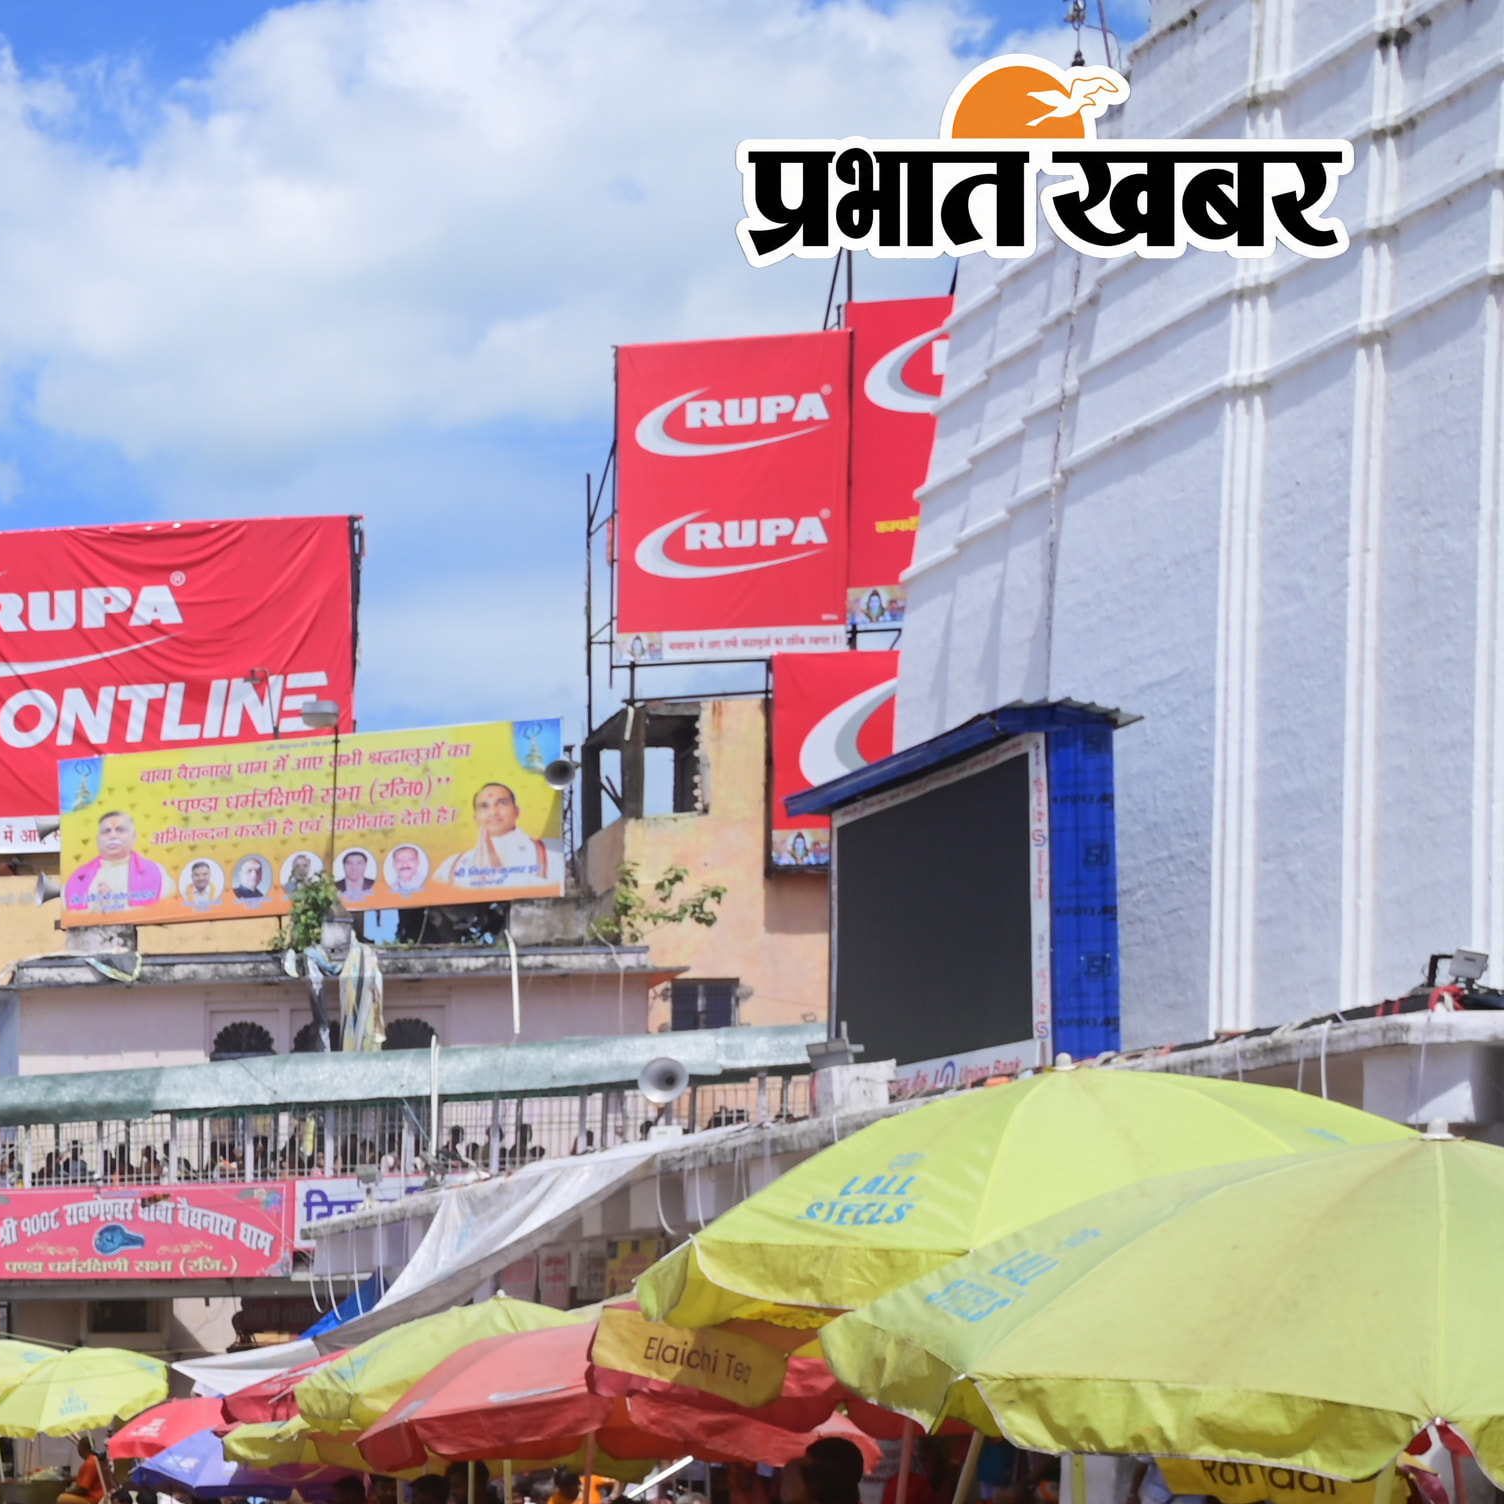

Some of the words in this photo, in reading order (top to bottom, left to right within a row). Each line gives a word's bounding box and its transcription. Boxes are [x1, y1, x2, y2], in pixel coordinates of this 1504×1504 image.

[684, 395, 829, 430] RUPA
[684, 516, 829, 551] RUPA
[293, 755, 323, 770] आए
[448, 744, 473, 759] का
[3, 825, 14, 843] में
[19, 828, 46, 846] आ
[993, 1057, 1021, 1077] Bank
[838, 1174, 919, 1197] LALL
[795, 1201, 916, 1226] STEELS
[20, 1208, 61, 1238] १००८
[240, 1221, 276, 1257] धाम
[4, 1259, 43, 1275] पण्डा
[134, 1259, 174, 1274] सभा
[643, 1336, 720, 1374] Elaichi
[725, 1353, 753, 1385] Tea
